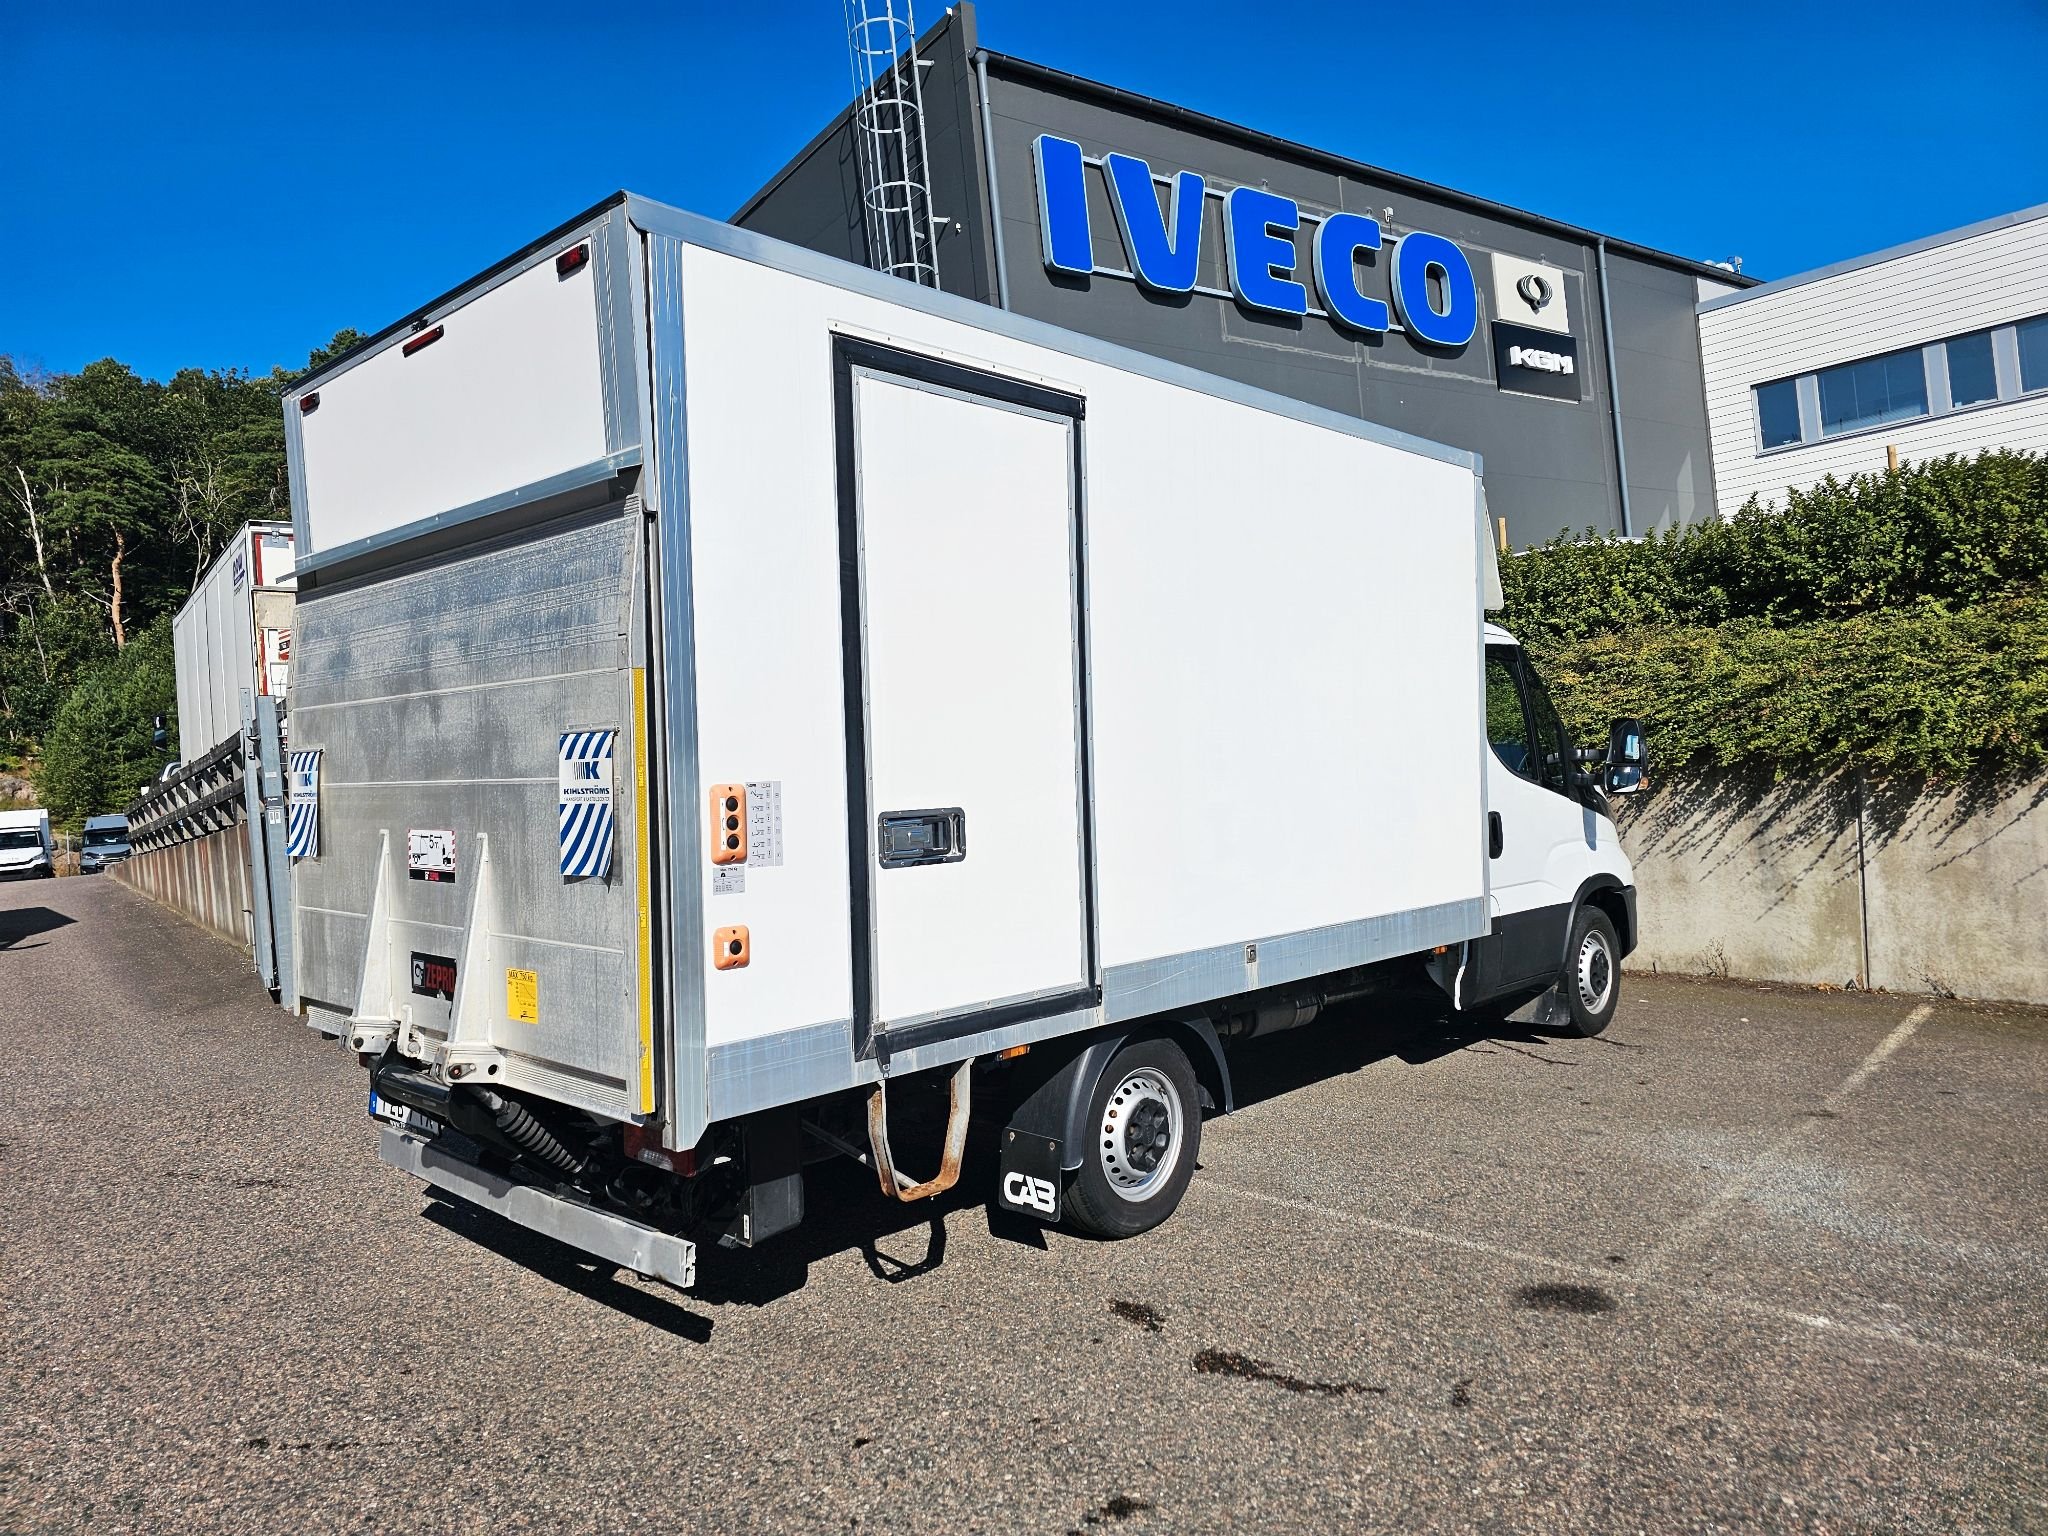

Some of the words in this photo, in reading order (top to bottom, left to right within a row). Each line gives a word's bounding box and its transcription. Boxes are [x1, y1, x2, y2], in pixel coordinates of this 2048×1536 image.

[1033, 134, 1478, 347] IVECO
[1509, 345, 1574, 375] KGM
[563, 784, 610, 795] KIHLSTRÖMS
[425, 962, 456, 993] ZEPRO
[1003, 1171, 1056, 1214] CAB
